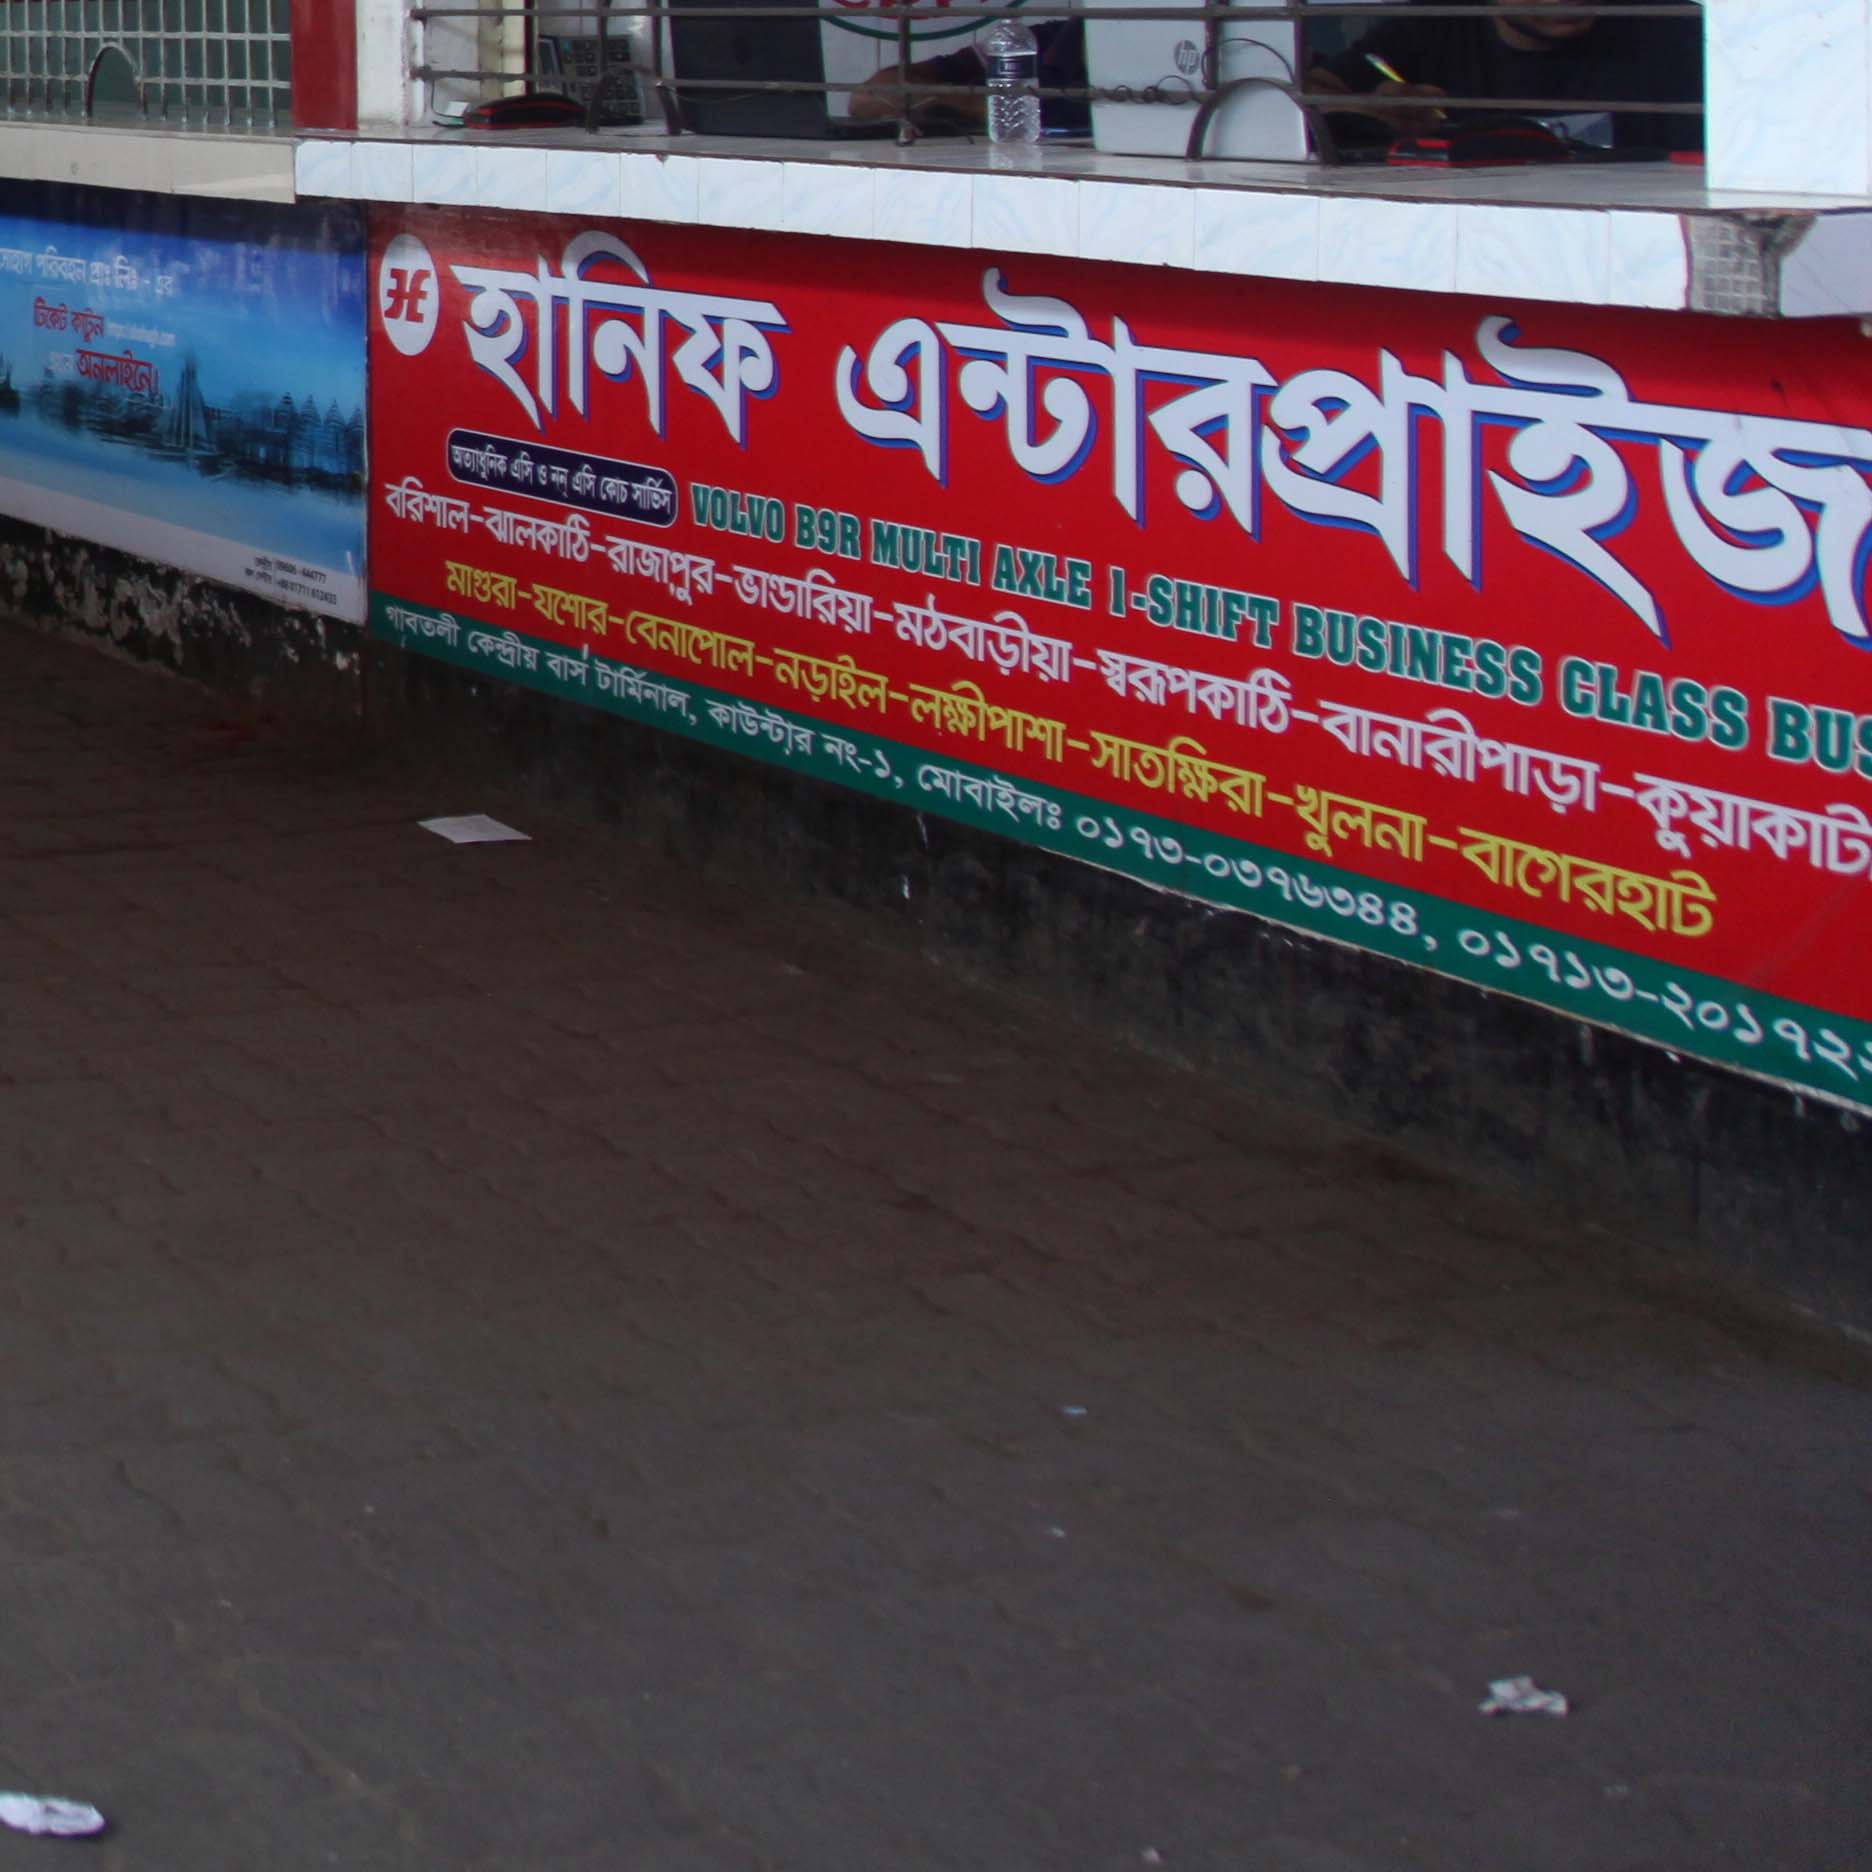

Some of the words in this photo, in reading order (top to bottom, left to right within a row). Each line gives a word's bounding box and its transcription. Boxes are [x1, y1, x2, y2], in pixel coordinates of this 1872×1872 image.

[1174, 43, 1202, 73] hp
[32, 295, 69, 332] টিকেট
[449, 230, 791, 448] হানিফ
[386, 602, 460, 651] গাবতলী
[467, 626, 538, 673] কেন্দ্রীয়
[546, 646, 589, 687] বাস
[594, 655, 698, 726] টার্মিনাল,
[707, 697, 813, 757] কাউন্টার
[689, 481, 786, 545] VOLVO
[794, 505, 862, 562] B9R
[869, 521, 981, 585] MULTI
[991, 544, 1093, 610] AXLE
[1292, 599, 1545, 707] BUSINESS
[1560, 658, 1751, 754] CLASS
